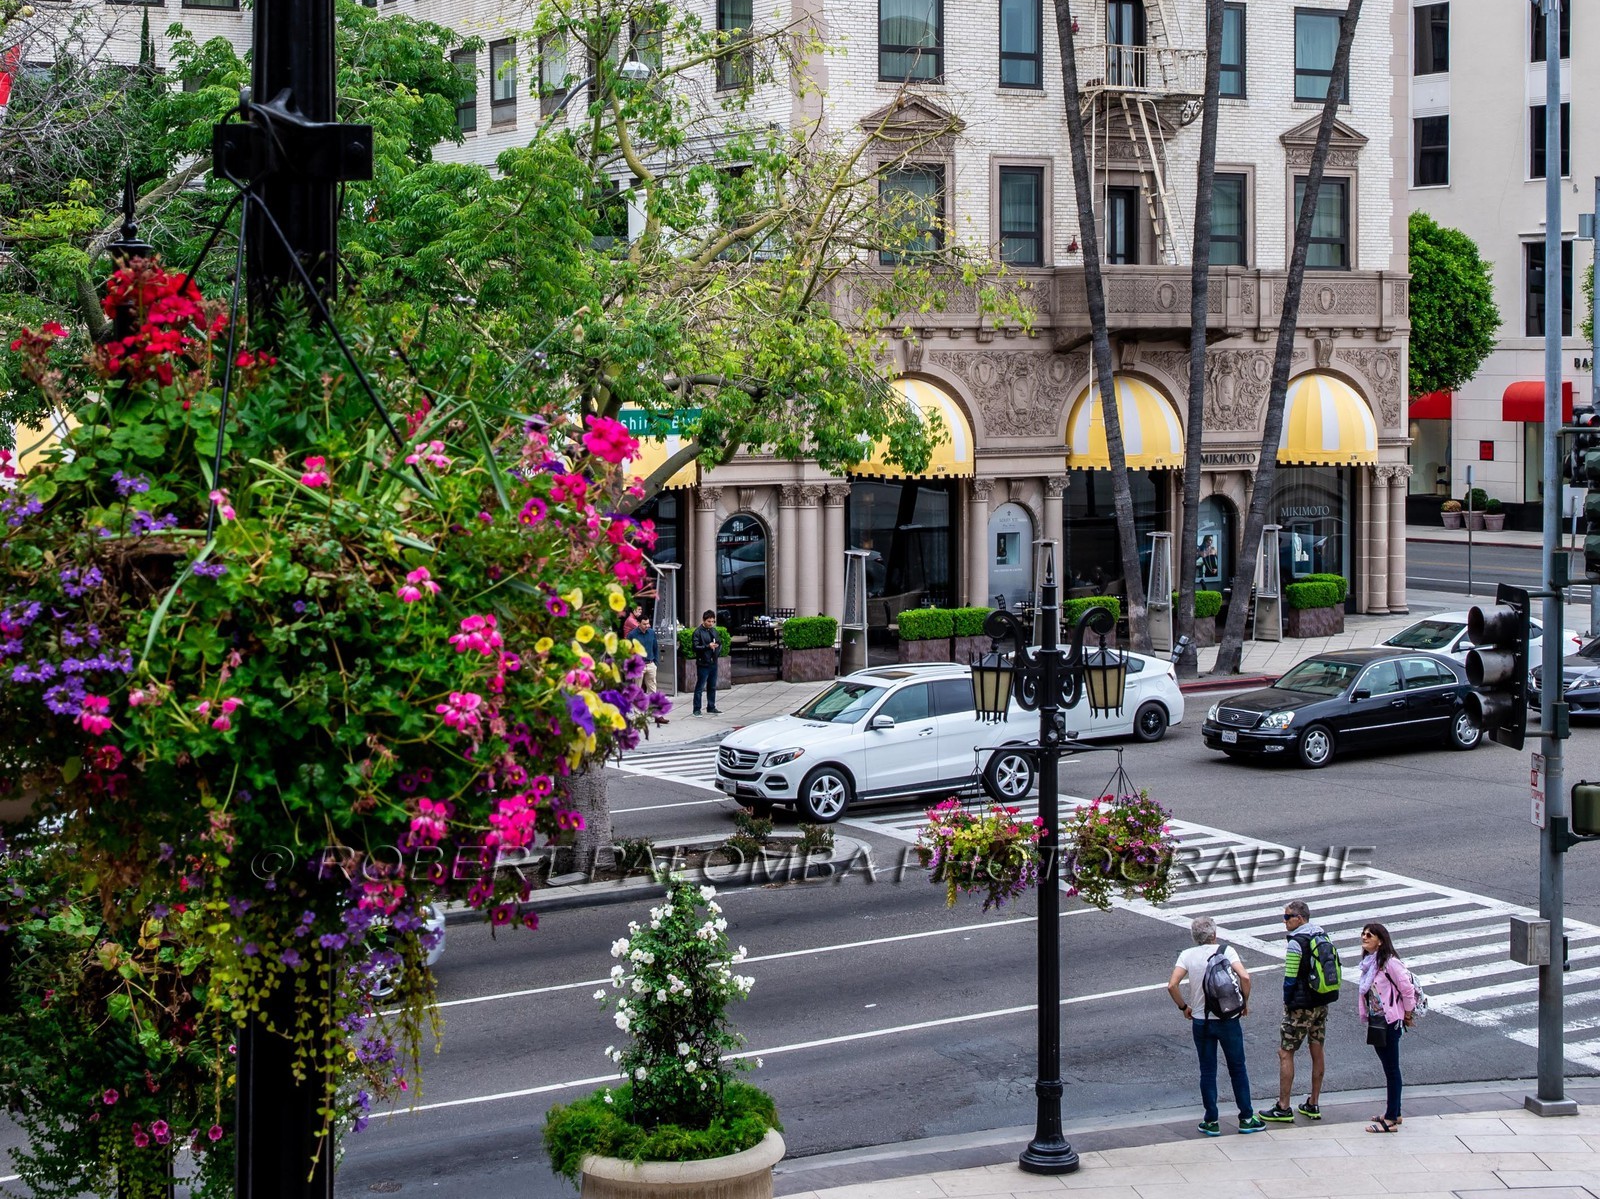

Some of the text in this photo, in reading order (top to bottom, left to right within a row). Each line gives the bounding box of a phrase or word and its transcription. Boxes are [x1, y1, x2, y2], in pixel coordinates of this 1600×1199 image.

[1574, 357, 1593, 369] BA
[1200, 453, 1256, 464] MIKIMOTO
[1281, 505, 1330, 517] MIKIMOTO
